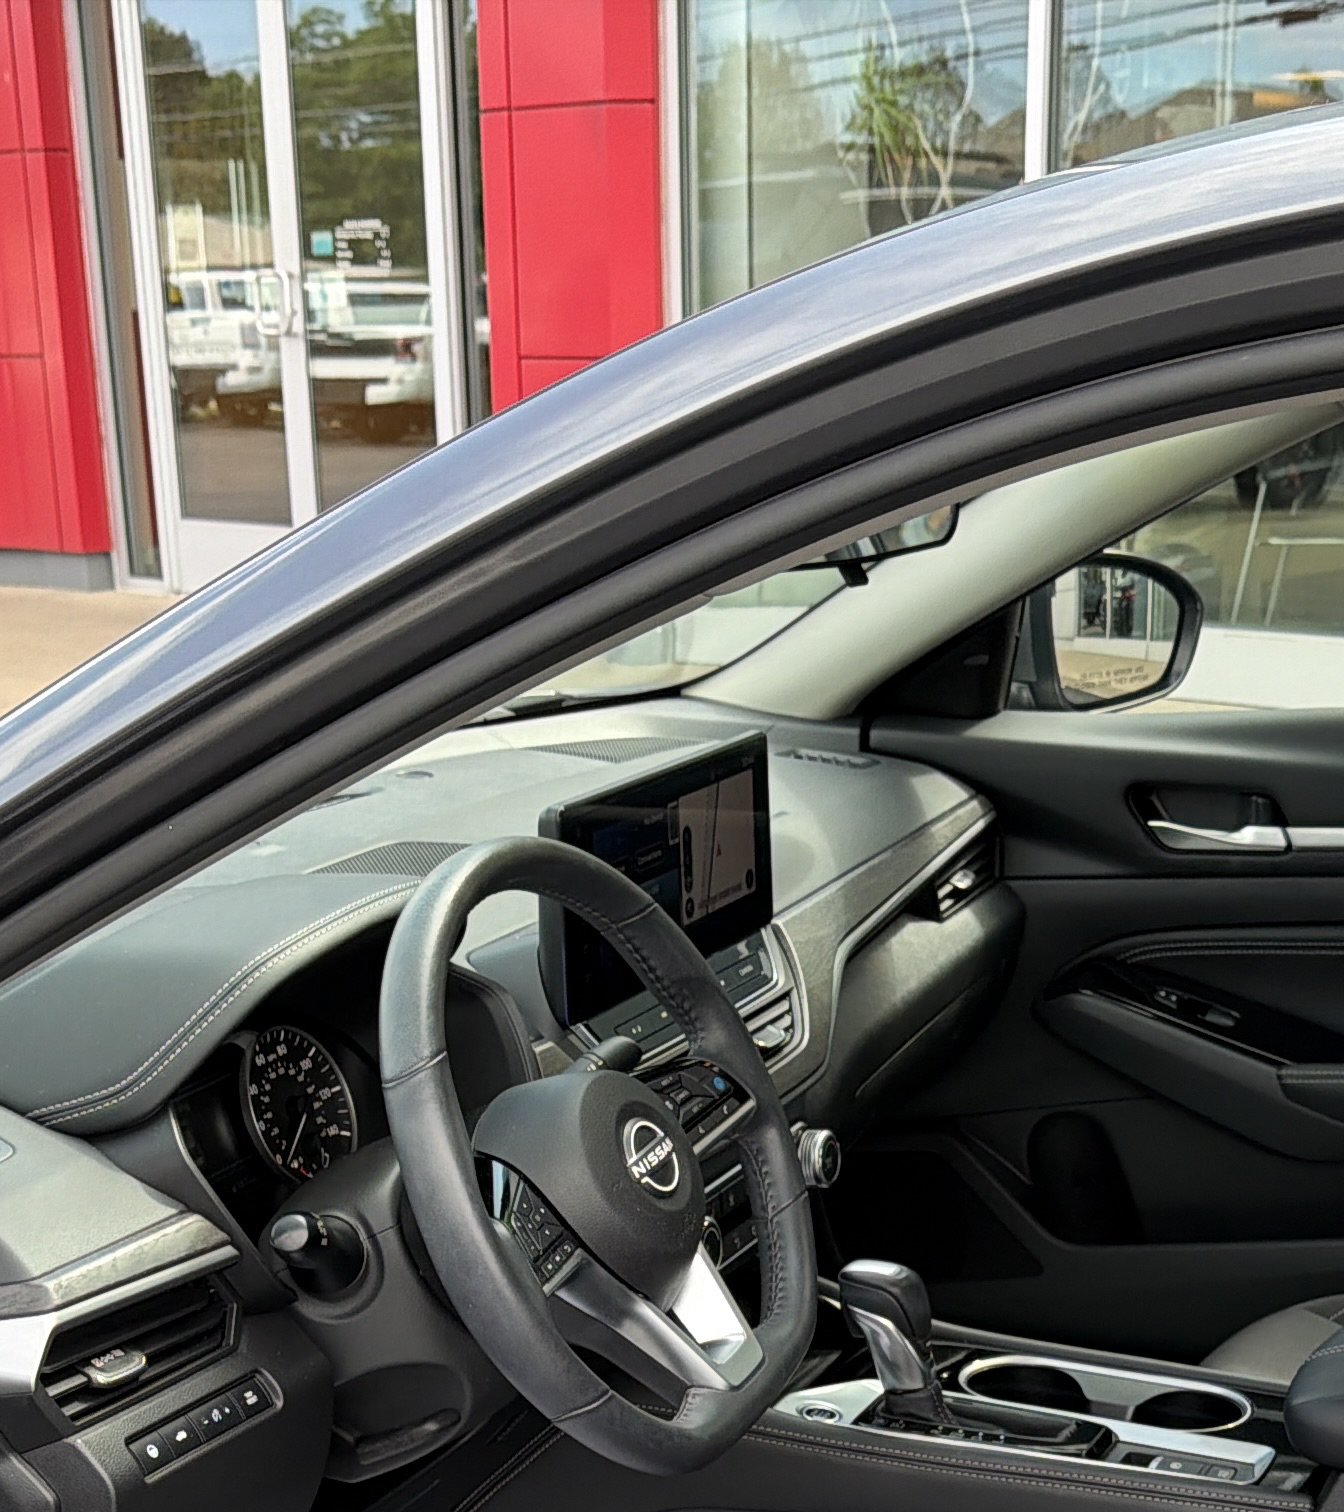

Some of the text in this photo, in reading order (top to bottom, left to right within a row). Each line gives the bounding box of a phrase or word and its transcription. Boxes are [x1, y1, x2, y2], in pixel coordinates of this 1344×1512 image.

[276, 1043, 287, 1057] 80
[255, 1053, 266, 1067] 60
[299, 1057, 313, 1071] 100
[319, 1087, 332, 1101] 120
[326, 1123, 340, 1138] 140
[630, 1136, 674, 1179] NISSAN
